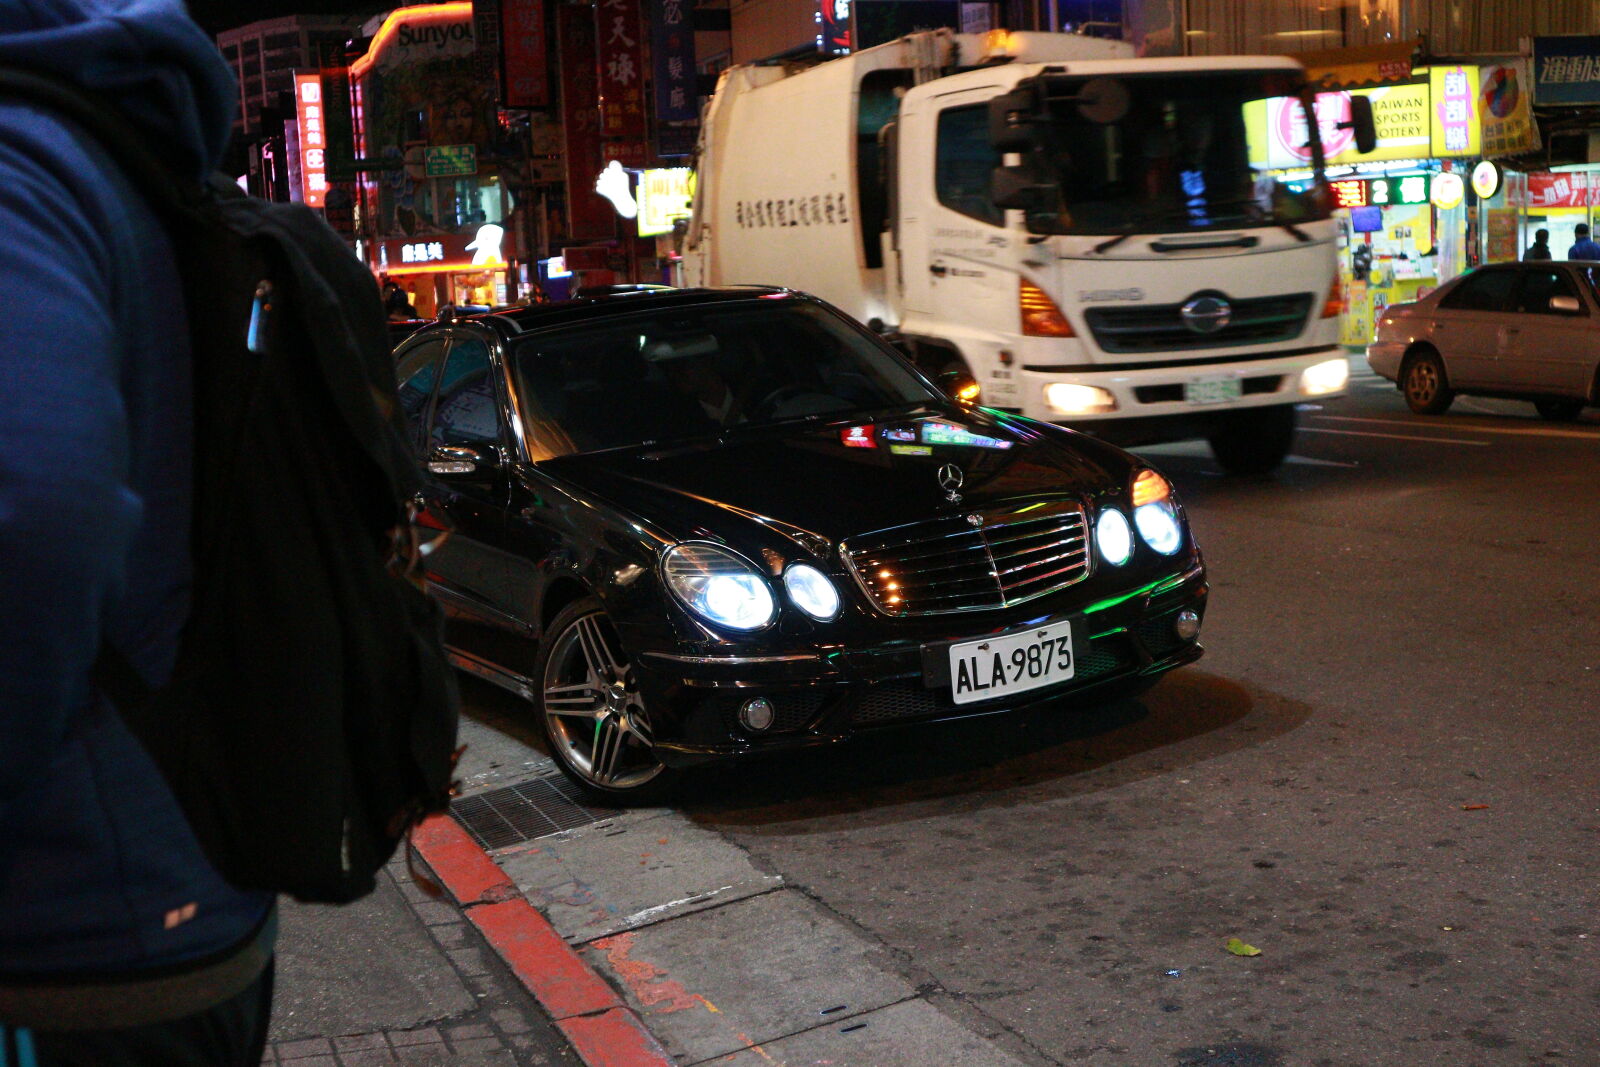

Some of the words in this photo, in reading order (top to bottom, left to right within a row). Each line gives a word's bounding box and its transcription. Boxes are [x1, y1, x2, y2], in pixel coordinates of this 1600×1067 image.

[1376, 112, 1421, 125] SPORTS
[1445, 72, 1467, 150] 刮刮樂
